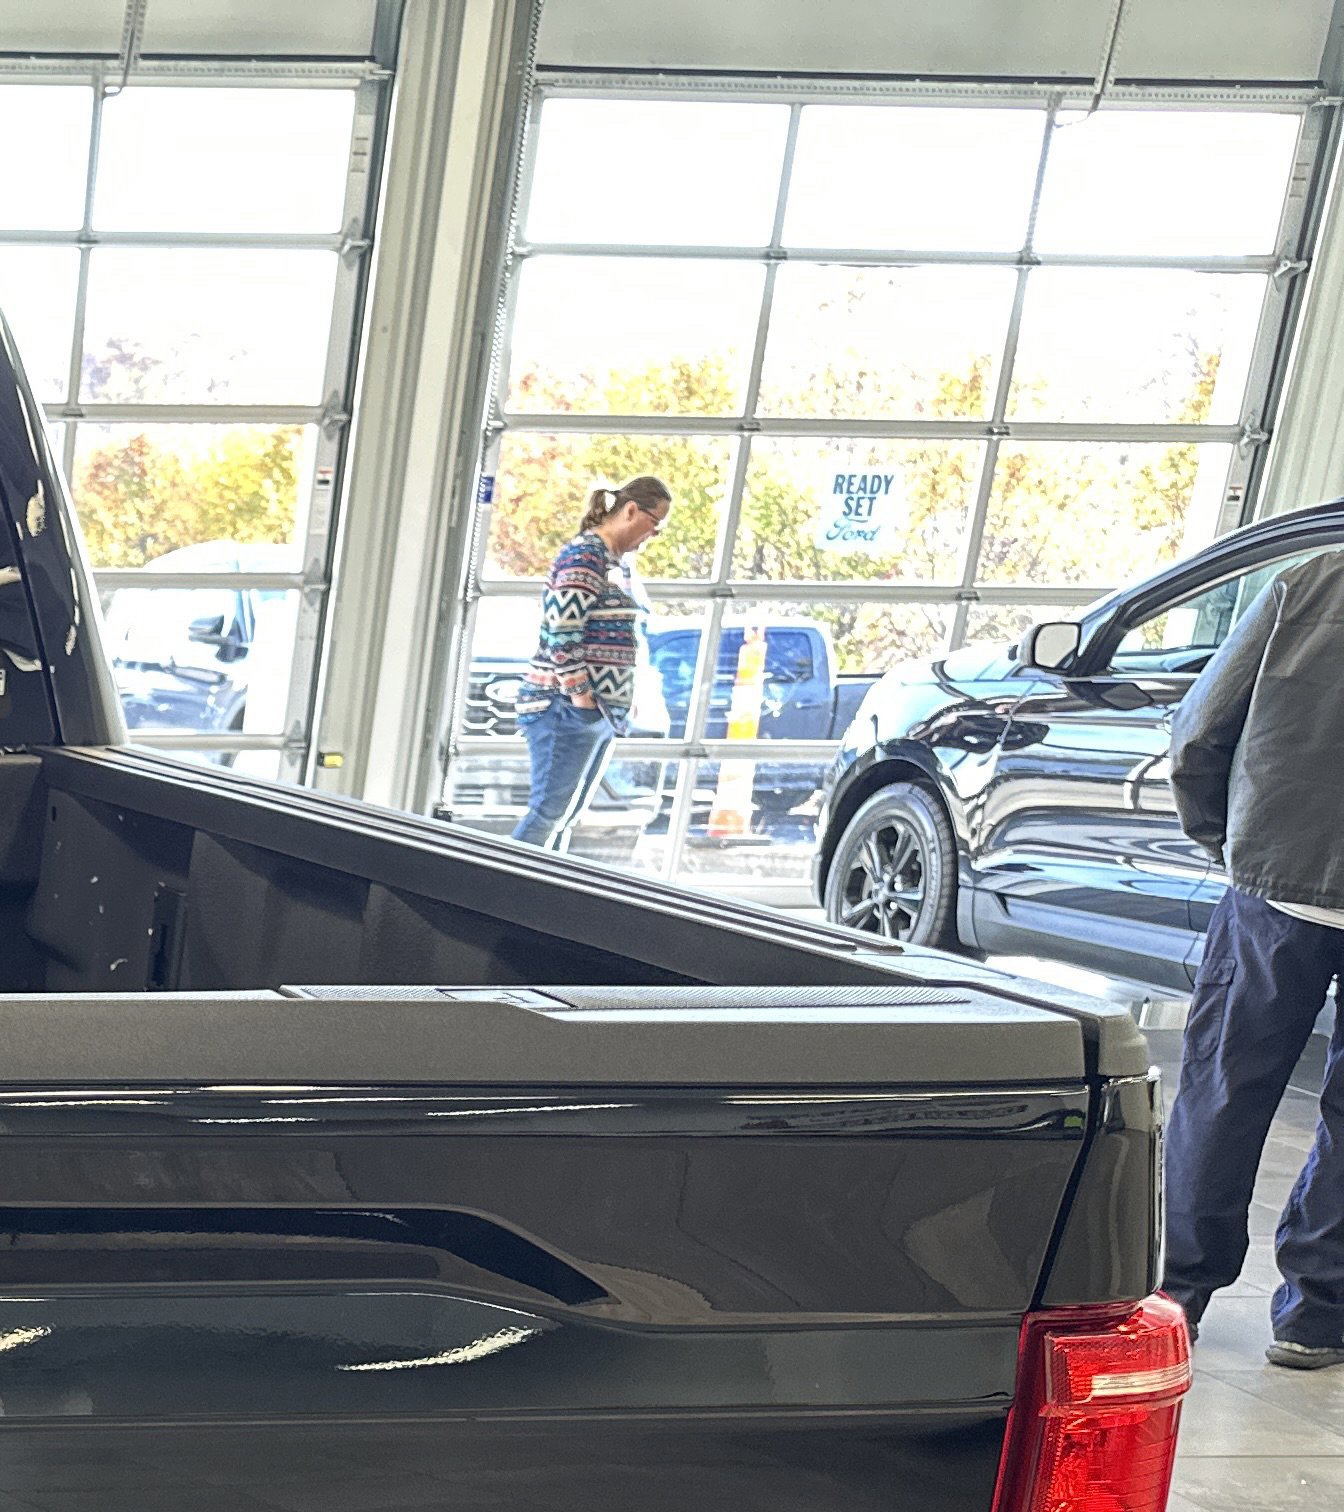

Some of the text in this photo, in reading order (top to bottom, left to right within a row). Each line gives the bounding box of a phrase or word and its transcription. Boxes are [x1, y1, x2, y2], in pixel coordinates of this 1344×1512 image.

[833, 474, 894, 494] READY
[842, 496, 877, 516] SET
[826, 519, 881, 541] Ford
